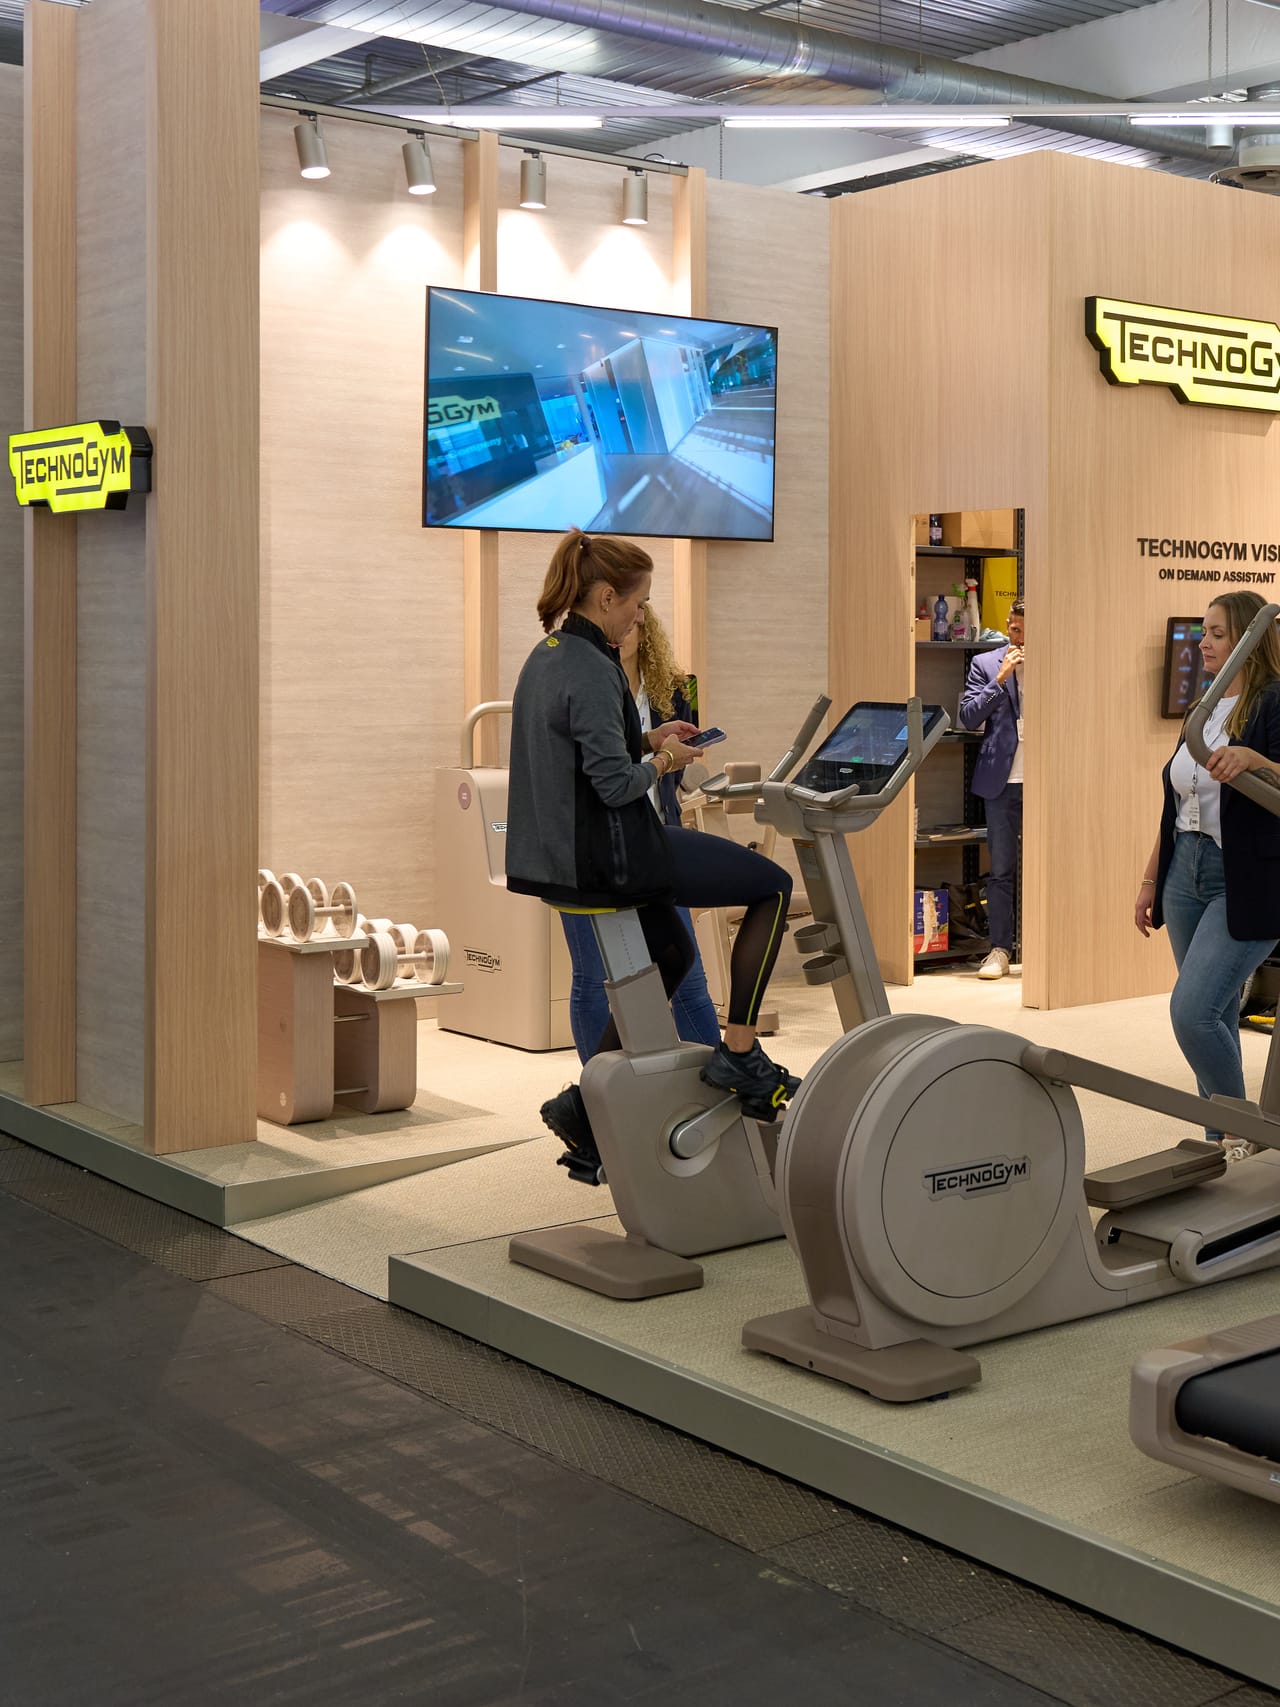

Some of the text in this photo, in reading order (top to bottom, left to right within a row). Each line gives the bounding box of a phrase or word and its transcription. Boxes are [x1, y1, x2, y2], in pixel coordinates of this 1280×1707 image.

[12, 436, 126, 496] TECHNOGYM
[1136, 537, 1247, 561] TECHNOGYM
[1158, 568, 1276, 584] ON DEMAND ASSISTANT
[463, 949, 501, 969] TECHNOGYM
[924, 1162, 1027, 1194] TECHNOGYM
